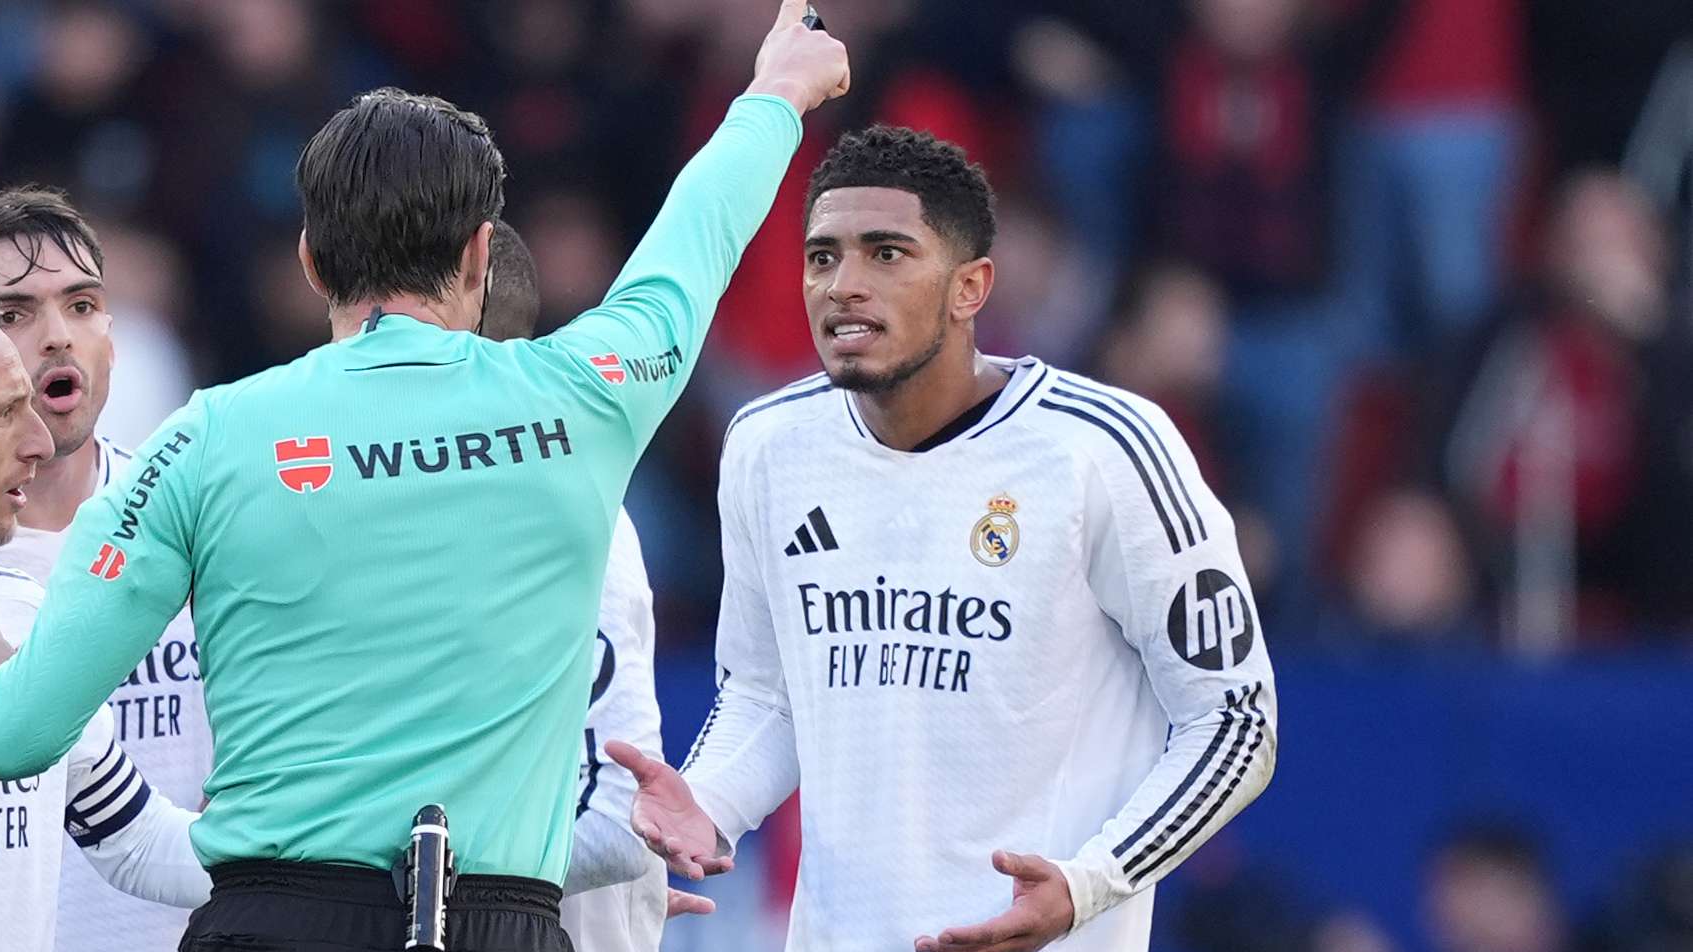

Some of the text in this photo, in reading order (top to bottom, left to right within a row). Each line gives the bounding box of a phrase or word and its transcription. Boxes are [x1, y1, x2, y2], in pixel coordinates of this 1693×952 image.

[346, 418, 572, 480] WÜRTH
[798, 575, 1012, 642] Emirates
[1184, 570, 1246, 670] hp
[828, 643, 972, 692] FLY BETTER
[107, 694, 182, 742] TTER
